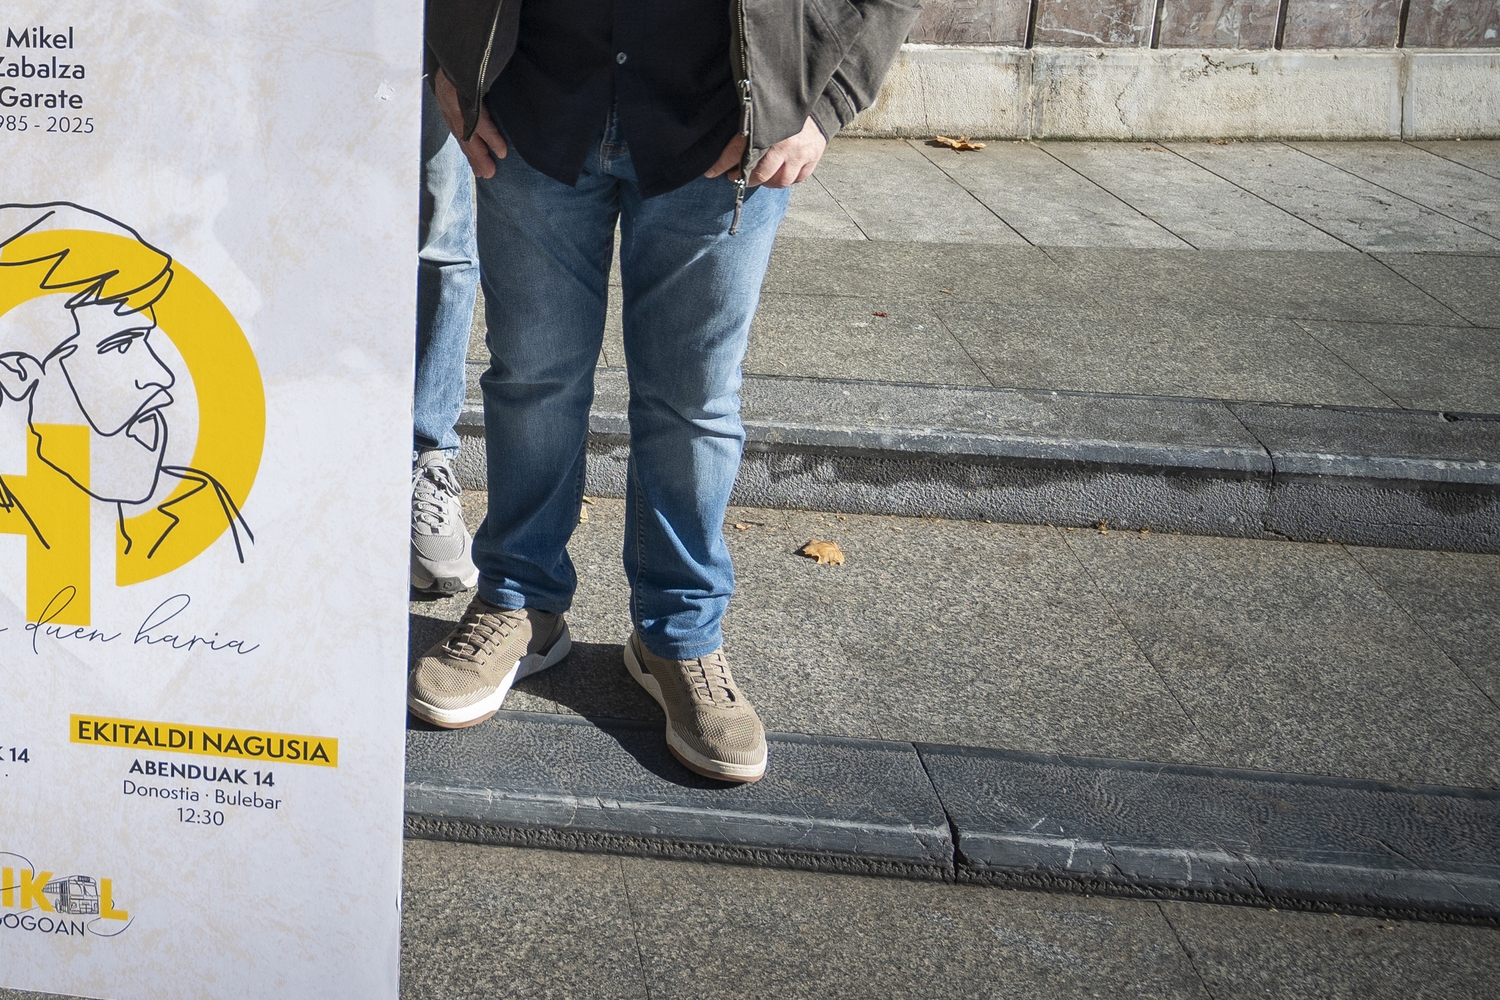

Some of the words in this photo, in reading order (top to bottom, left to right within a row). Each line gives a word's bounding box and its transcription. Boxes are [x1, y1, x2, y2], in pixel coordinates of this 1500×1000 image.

[6, 26, 74, 49] Mikel
[46, 116, 95, 134] 2025
[24, 585, 123, 655] duen
[133, 593, 261, 655] haria
[78, 720, 194, 750] EKITALDI
[202, 731, 331, 763] NAGUSIA
[9, 747, 30, 764] 14
[128, 758, 248, 785] ABENDUAK
[253, 770, 275, 788] 14
[123, 779, 199, 802] Donostia
[215, 788, 282, 810] Bulebar
[177, 807, 225, 826] 12:30
